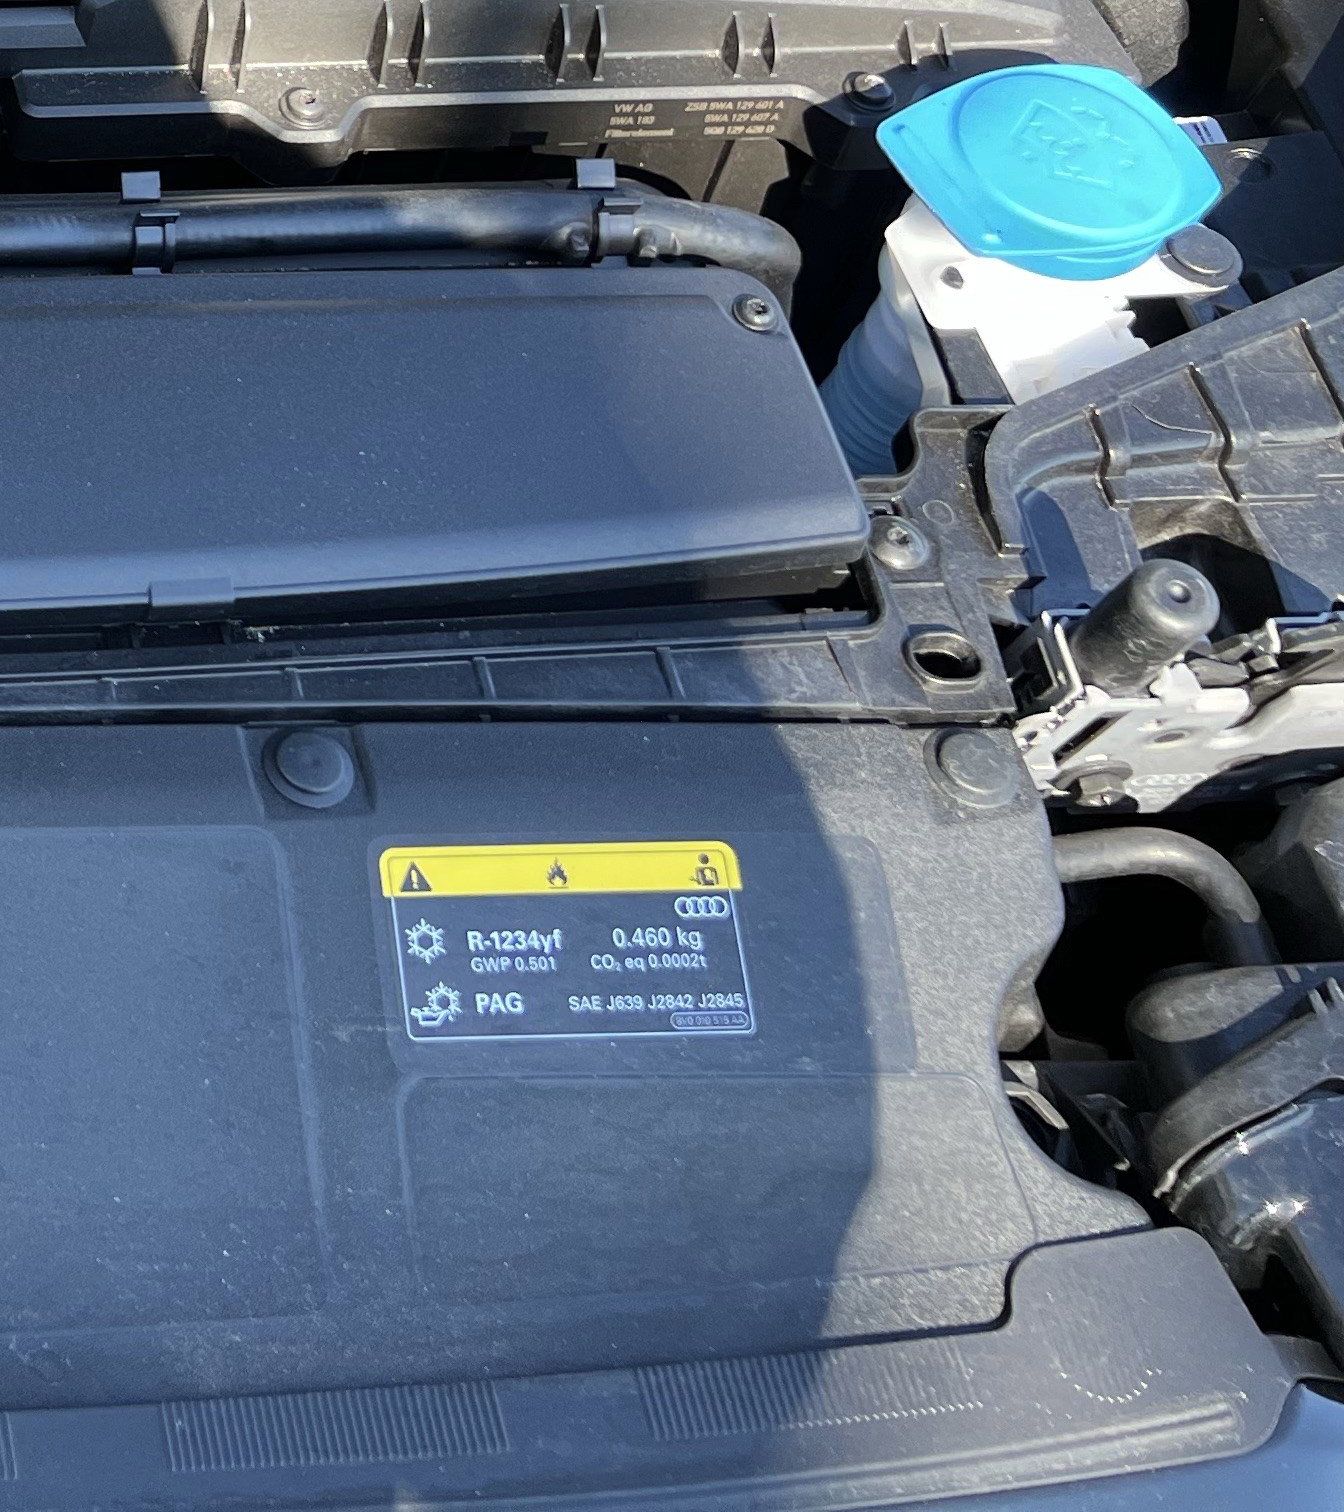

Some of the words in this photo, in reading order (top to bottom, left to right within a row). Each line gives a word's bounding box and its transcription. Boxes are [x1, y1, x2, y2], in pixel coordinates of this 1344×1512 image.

[466, 928, 562, 953] R-1234yf
[612, 927, 672, 948] 0.460
[676, 925, 703, 950] kg
[470, 956, 512, 973] GWP
[514, 955, 557, 971] 0.501
[624, 956, 647, 972] eq
[647, 953, 708, 969] 0.0002t
[475, 991, 526, 1015] PAG
[568, 994, 602, 1011] SAE
[606, 994, 644, 1011] J639
[647, 993, 694, 1009] J2842
[698, 992, 745, 1009] J2845
